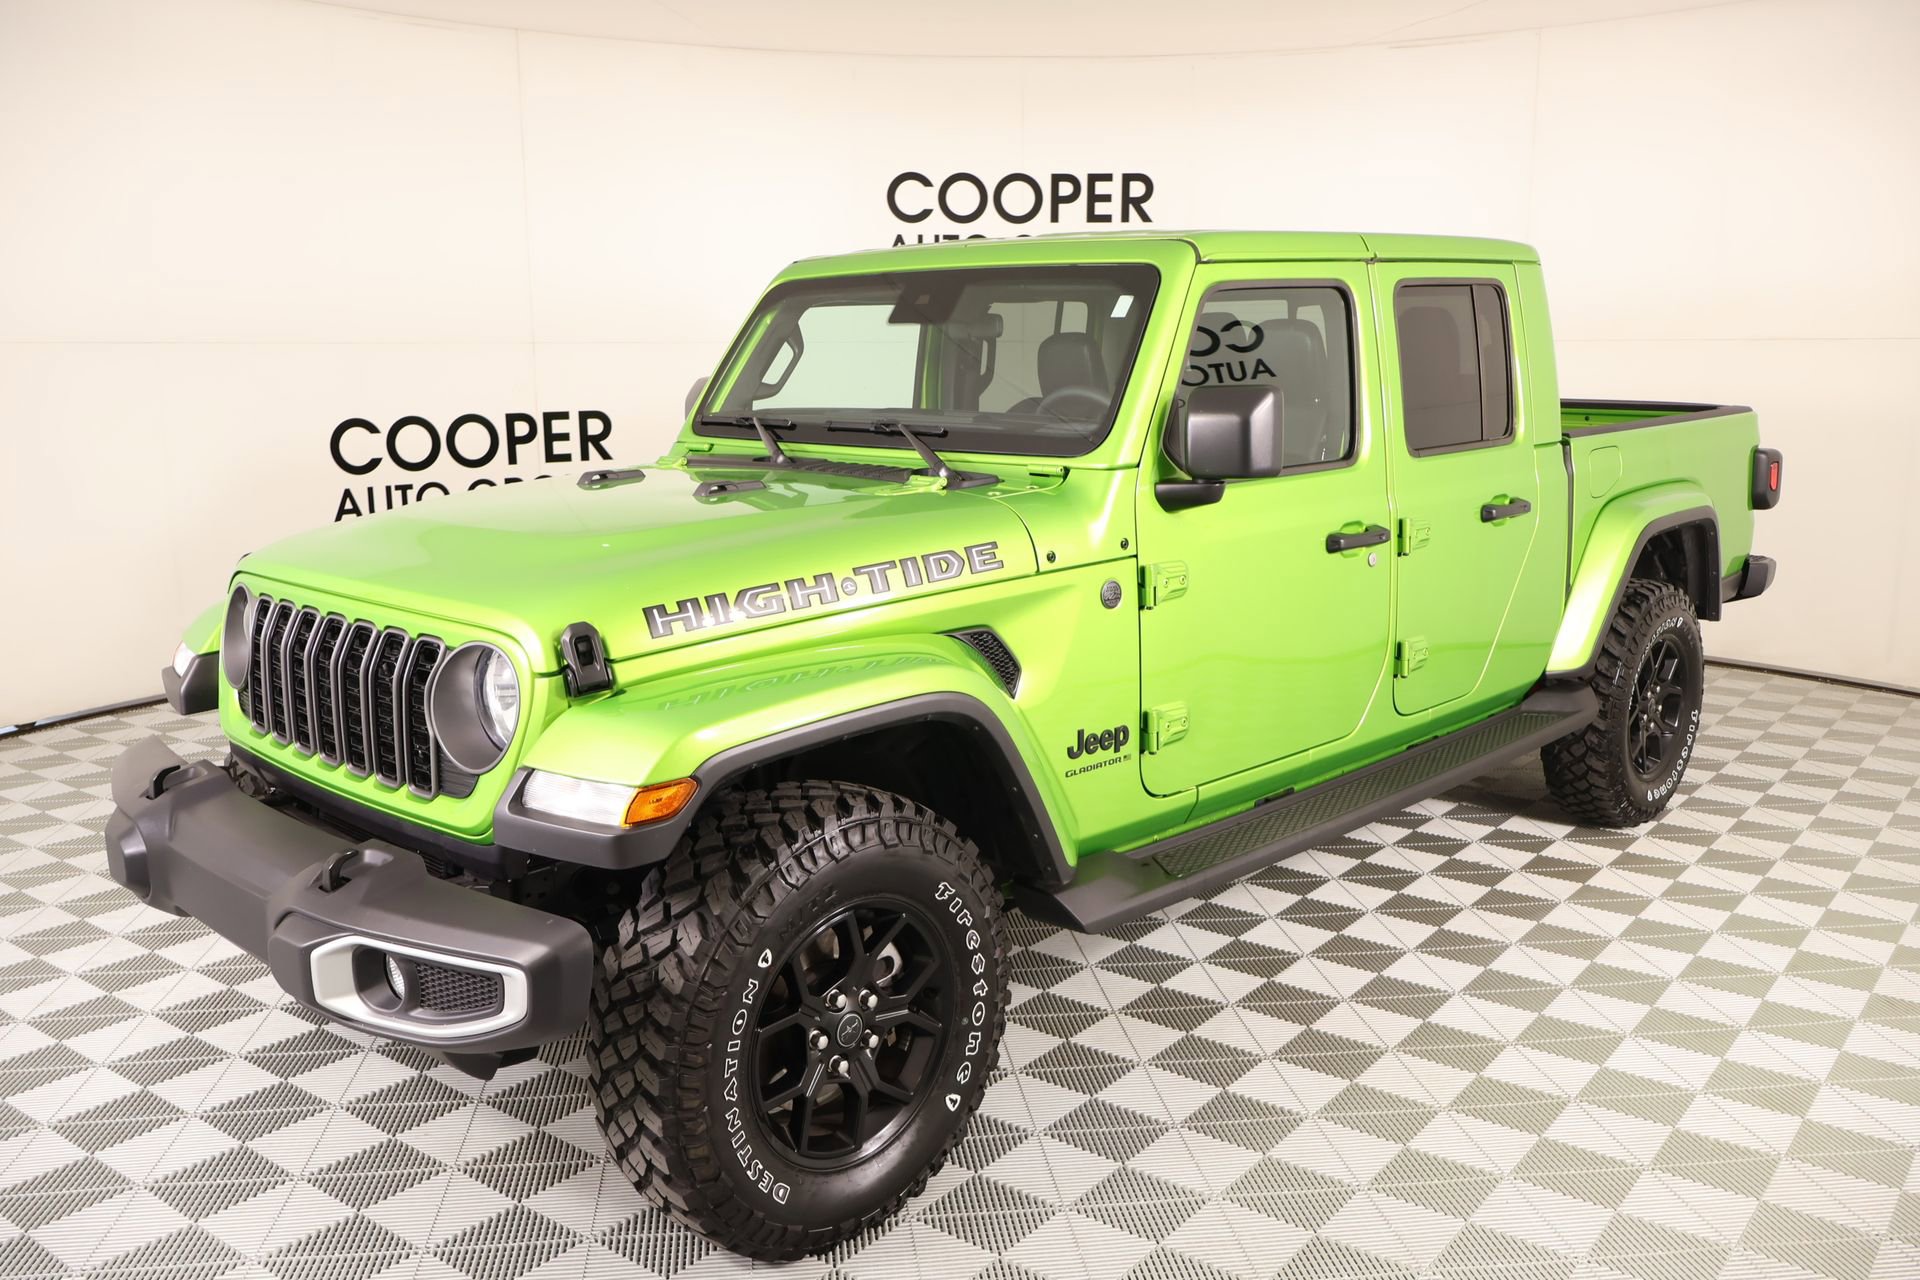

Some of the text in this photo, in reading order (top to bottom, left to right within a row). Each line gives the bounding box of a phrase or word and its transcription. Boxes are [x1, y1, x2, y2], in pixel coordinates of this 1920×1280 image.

[886, 171, 1154, 224] COOPER
[330, 410, 613, 475] COOPER
[642, 541, 1004, 639] HIGH TIDE
[1065, 756, 1122, 778] GLADIATOR
[1066, 725, 1130, 760] Jeep
[724, 979, 790, 1204] DESTINATION
